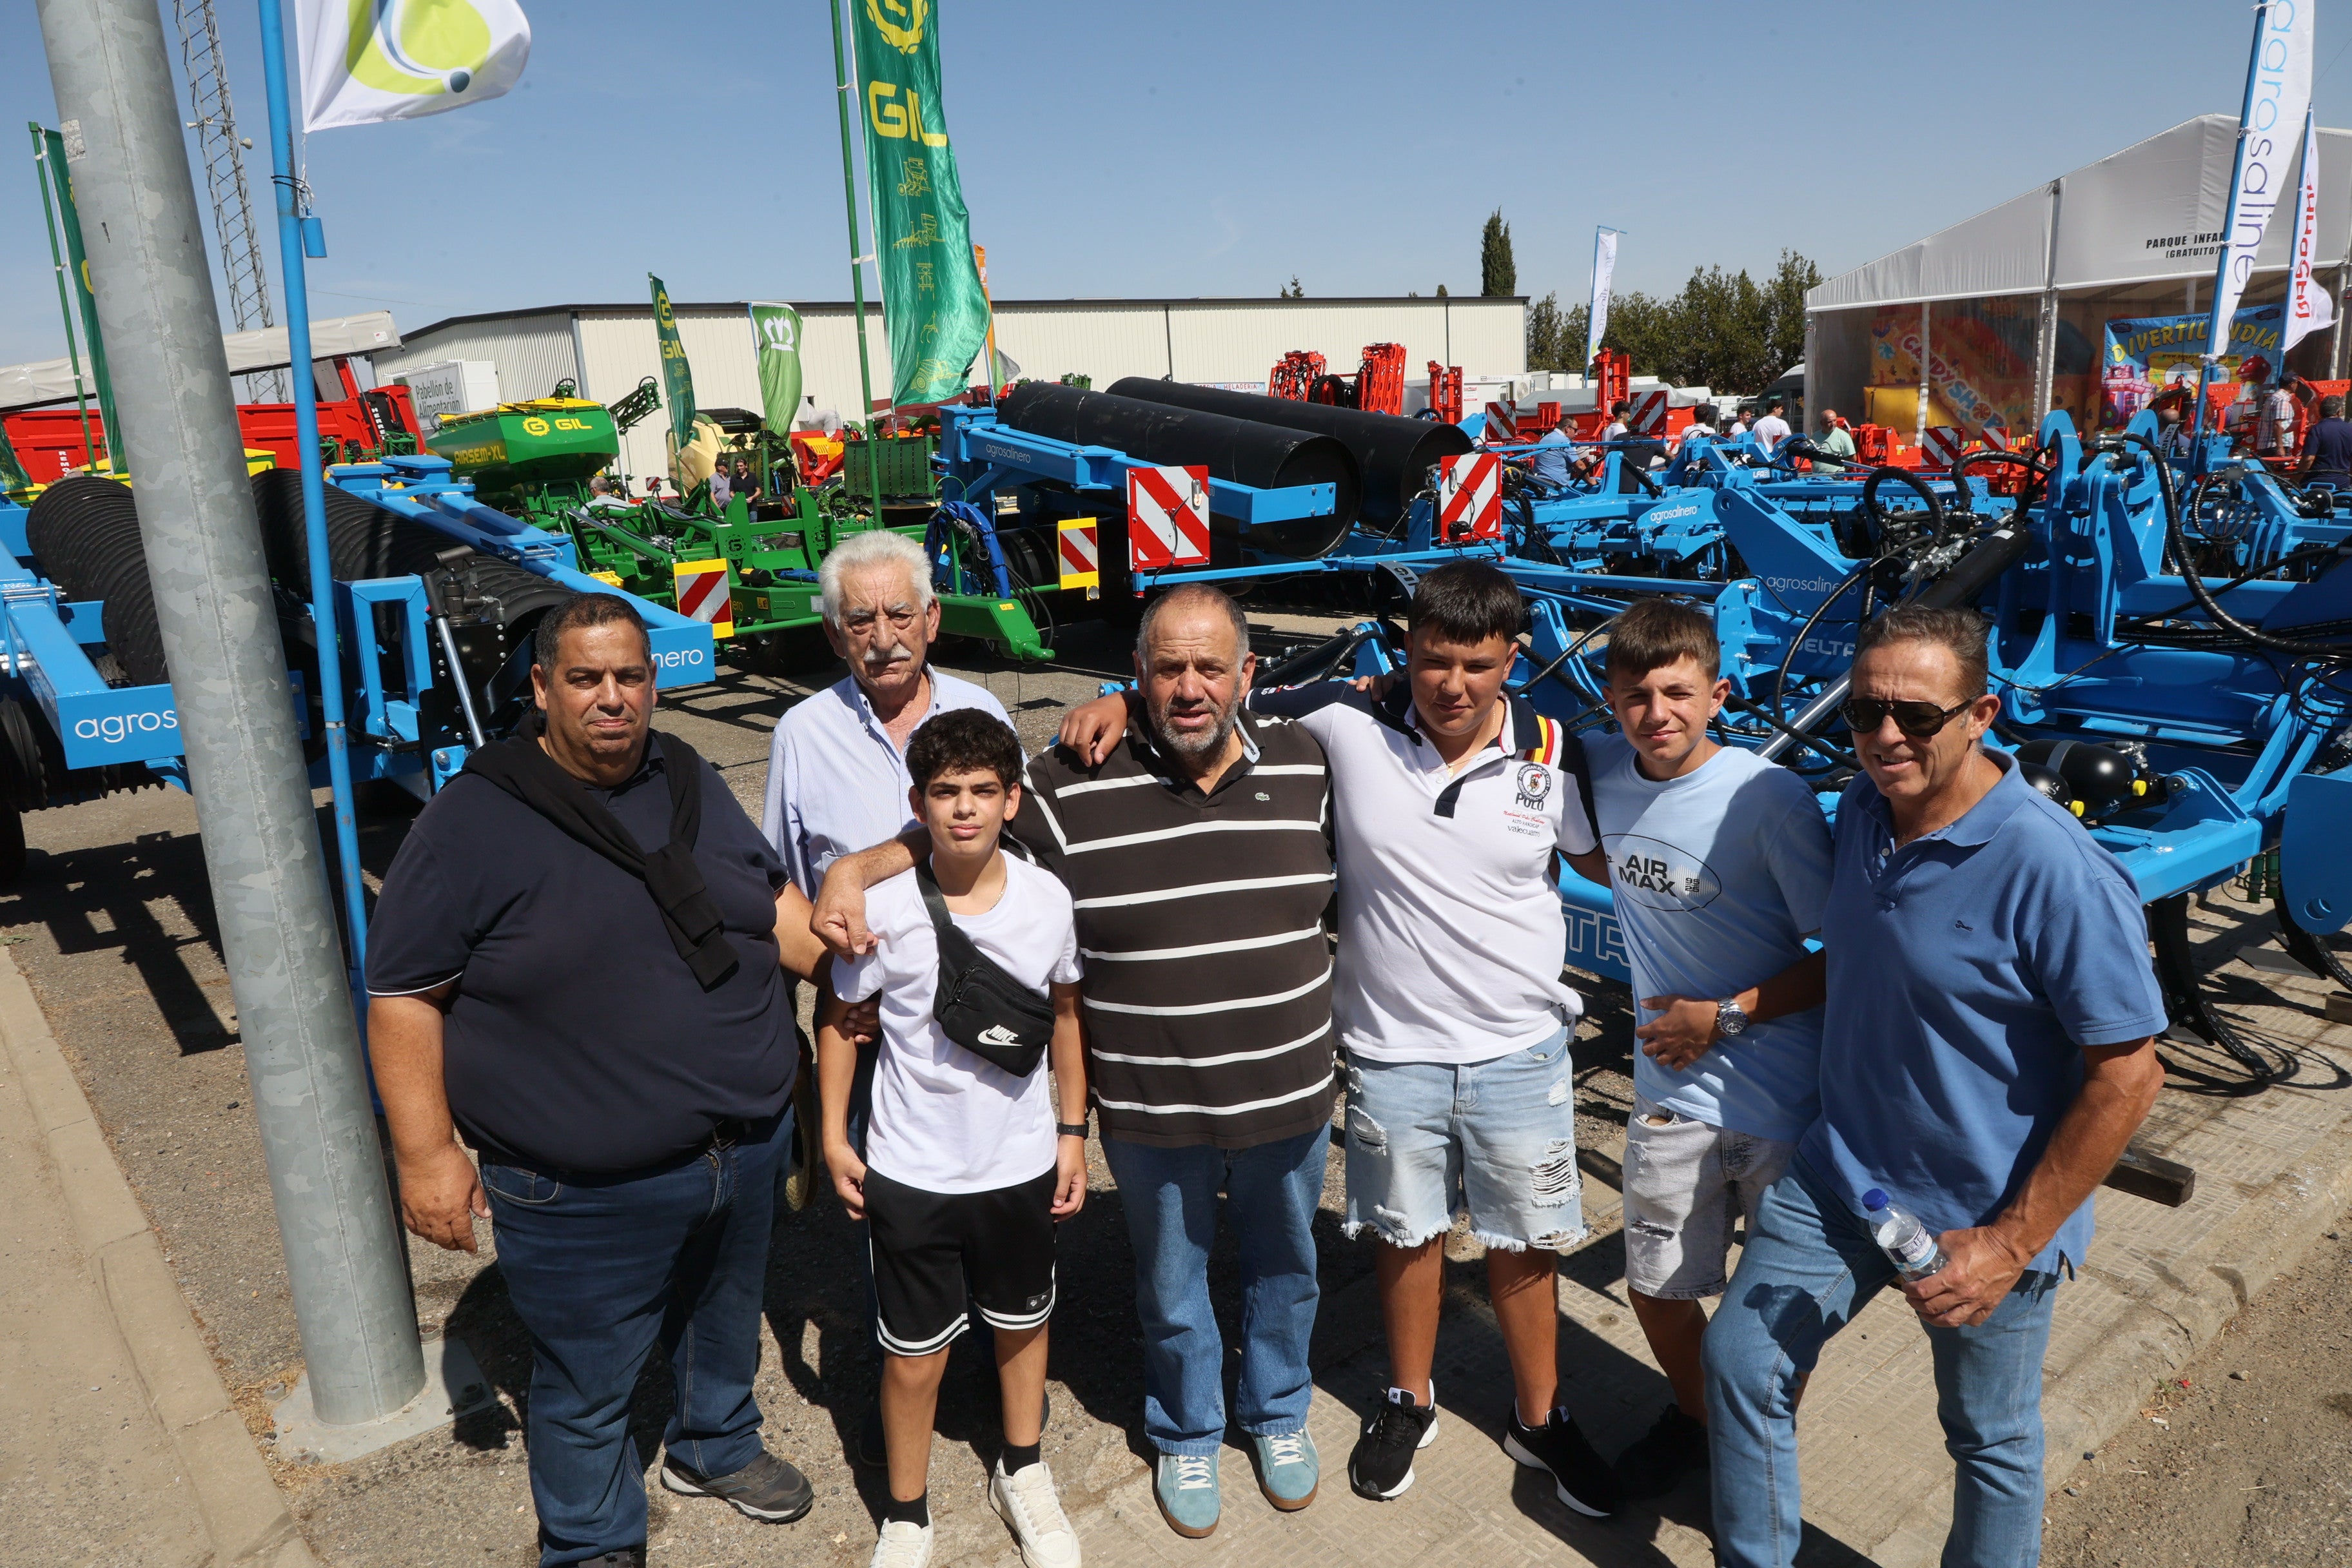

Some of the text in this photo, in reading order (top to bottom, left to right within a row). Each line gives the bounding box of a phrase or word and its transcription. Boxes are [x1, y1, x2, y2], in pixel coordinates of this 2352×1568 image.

[868, 81, 948, 146] GIL
[2146, 236, 2187, 249] PARQUE
[662, 340, 686, 359] GIL
[2112, 321, 2278, 362] DIVERTILNDIA
[415, 377, 454, 400] Pabellón de
[554, 418, 593, 431] GIL
[454, 445, 507, 466] AIRSEM-XL
[986, 444, 1032, 464] agrosalinero
[1650, 504, 1698, 524] agrosalinero
[1767, 575, 1857, 595] agrosalineo
[75, 708, 178, 744] agros
[1515, 792, 1544, 812] POLO
[1625, 854, 1667, 879] AIR
[1618, 865, 1677, 897] MAX
[986, 1024, 1019, 1044] NIKE
